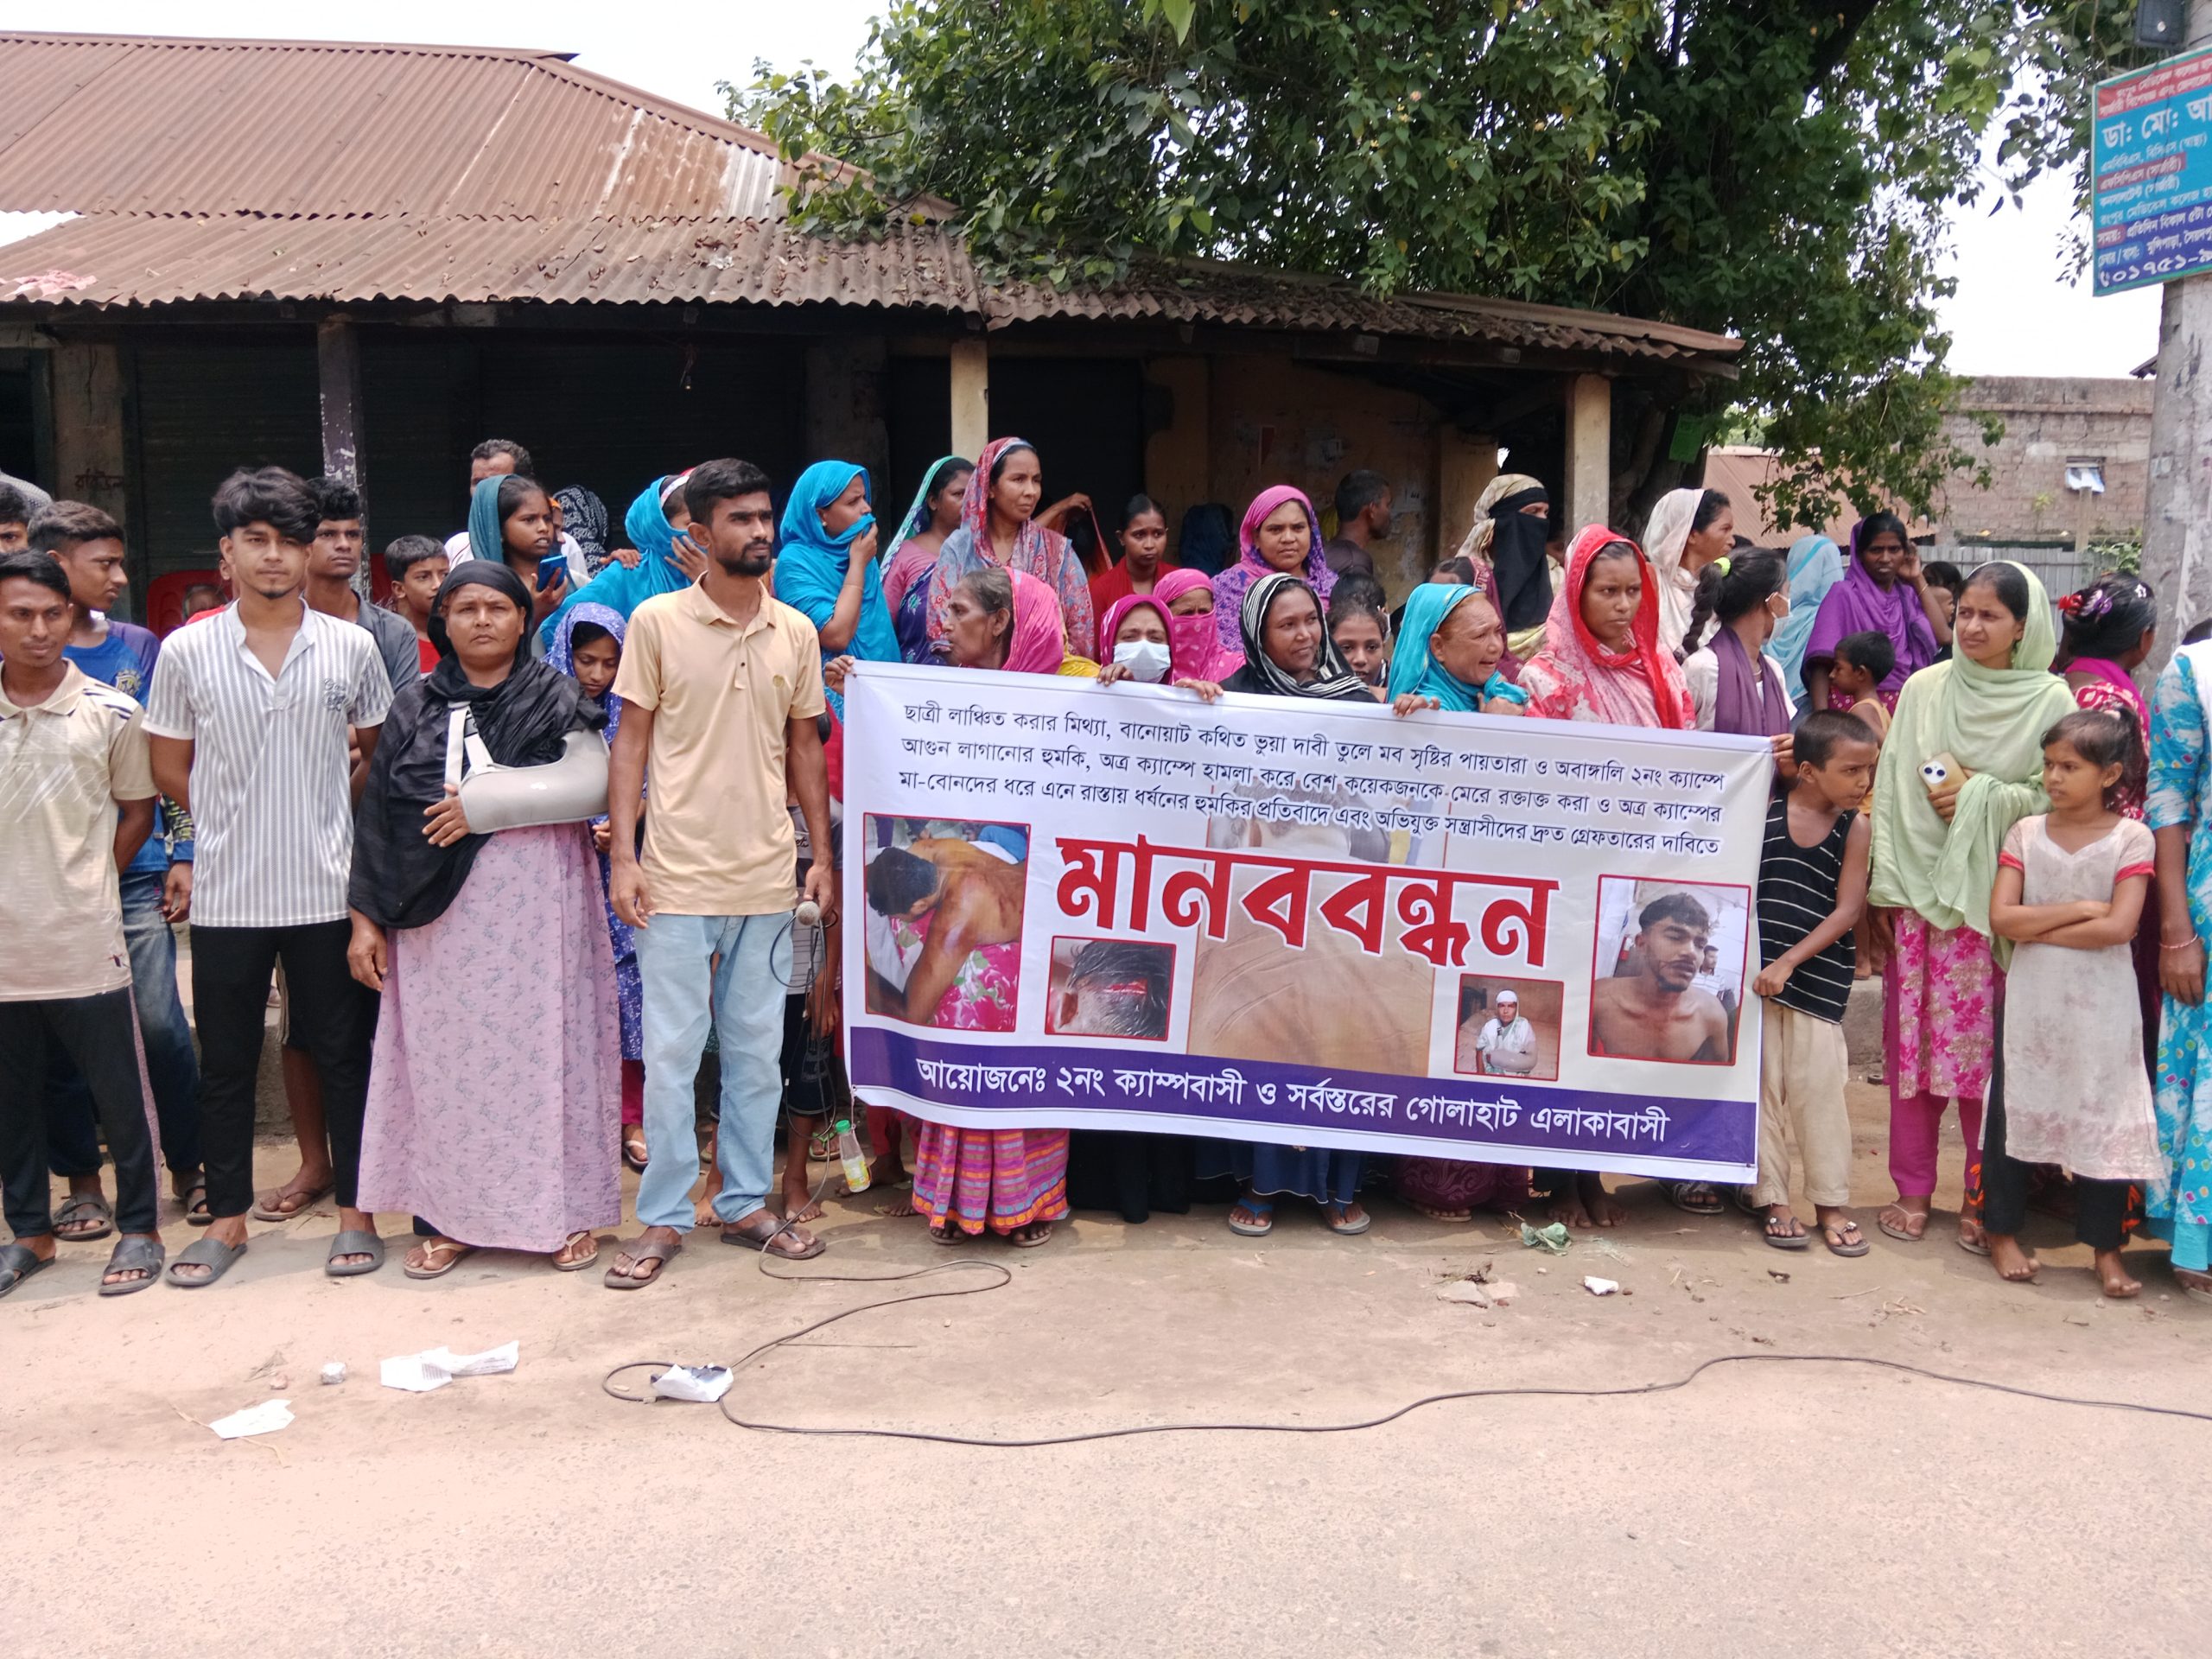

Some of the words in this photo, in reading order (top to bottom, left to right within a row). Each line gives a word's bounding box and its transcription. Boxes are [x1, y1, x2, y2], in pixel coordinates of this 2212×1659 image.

[901, 738, 951, 757] আগুন
[957, 741, 1035, 763] লাগানোর
[1041, 745, 1090, 772] হুমকি,
[1099, 753, 1131, 771] অত্র
[1137, 757, 1197, 778] ক্যাম্পে
[1202, 762, 1253, 785] হামলা
[1260, 768, 1296, 787] করে
[1302, 772, 1338, 791] বেশ
[1344, 776, 1446, 801] কয়েকজনকে
[1451, 785, 1492, 804] মেরে
[1498, 789, 1551, 808] রক্তাক্ত
[1557, 794, 1591, 812] করা
[1598, 799, 1610, 813] ও
[1618, 799, 1647, 817] অত্র
[1654, 801, 1722, 823] ক্যাম্পের
[904, 701, 943, 724] ছাত্রী
[1014, 713, 1058, 731] করার
[1065, 712, 1111, 741] মিথ্যা,
[1120, 721, 1192, 745] বানোয়াট
[1198, 725, 1249, 747] কথিত
[1255, 734, 1287, 756] ভুয়া
[1294, 734, 1330, 756] দাবী
[1335, 742, 1372, 762] তুলে
[1379, 747, 1404, 762] মব
[1411, 745, 1453, 772] সৃষ্টির
[1535, 760, 1548, 775] ও
[1632, 769, 1662, 787] ২নং
[1669, 770, 1725, 791] ক্যাম্পে
[899, 772, 999, 794] মা-বোনদের
[1004, 779, 1036, 796] ধরে
[1041, 782, 1076, 800] এনে
[1080, 784, 1130, 804] রাস্তায়
[1195, 792, 1253, 816] হুমকির
[1257, 796, 1332, 823] প্রতিবাদে
[1336, 809, 1370, 830] এবং
[1376, 808, 1440, 836] অভিযুক্ত
[1446, 814, 1529, 840] সন্ত্রাসীদের
[1533, 824, 1567, 842] দ্রুত
[1572, 827, 1656, 851] গ্রেফতারের
[1662, 831, 1721, 855] দাবিতে
[1055, 834, 1560, 968] মানববন্ধন
[916, 1057, 1046, 1094] আয়োজনেঃ
[1057, 1066, 1106, 1096] ২নং
[1114, 1067, 1248, 1105] ক্যাম্পবাসী
[1255, 1082, 1277, 1106] ও
[1286, 1077, 1397, 1119] সর্বস্তরের
[1406, 1094, 1522, 1133] গোলাহাট
[1531, 1105, 1671, 1142] এলাকাবাসী
